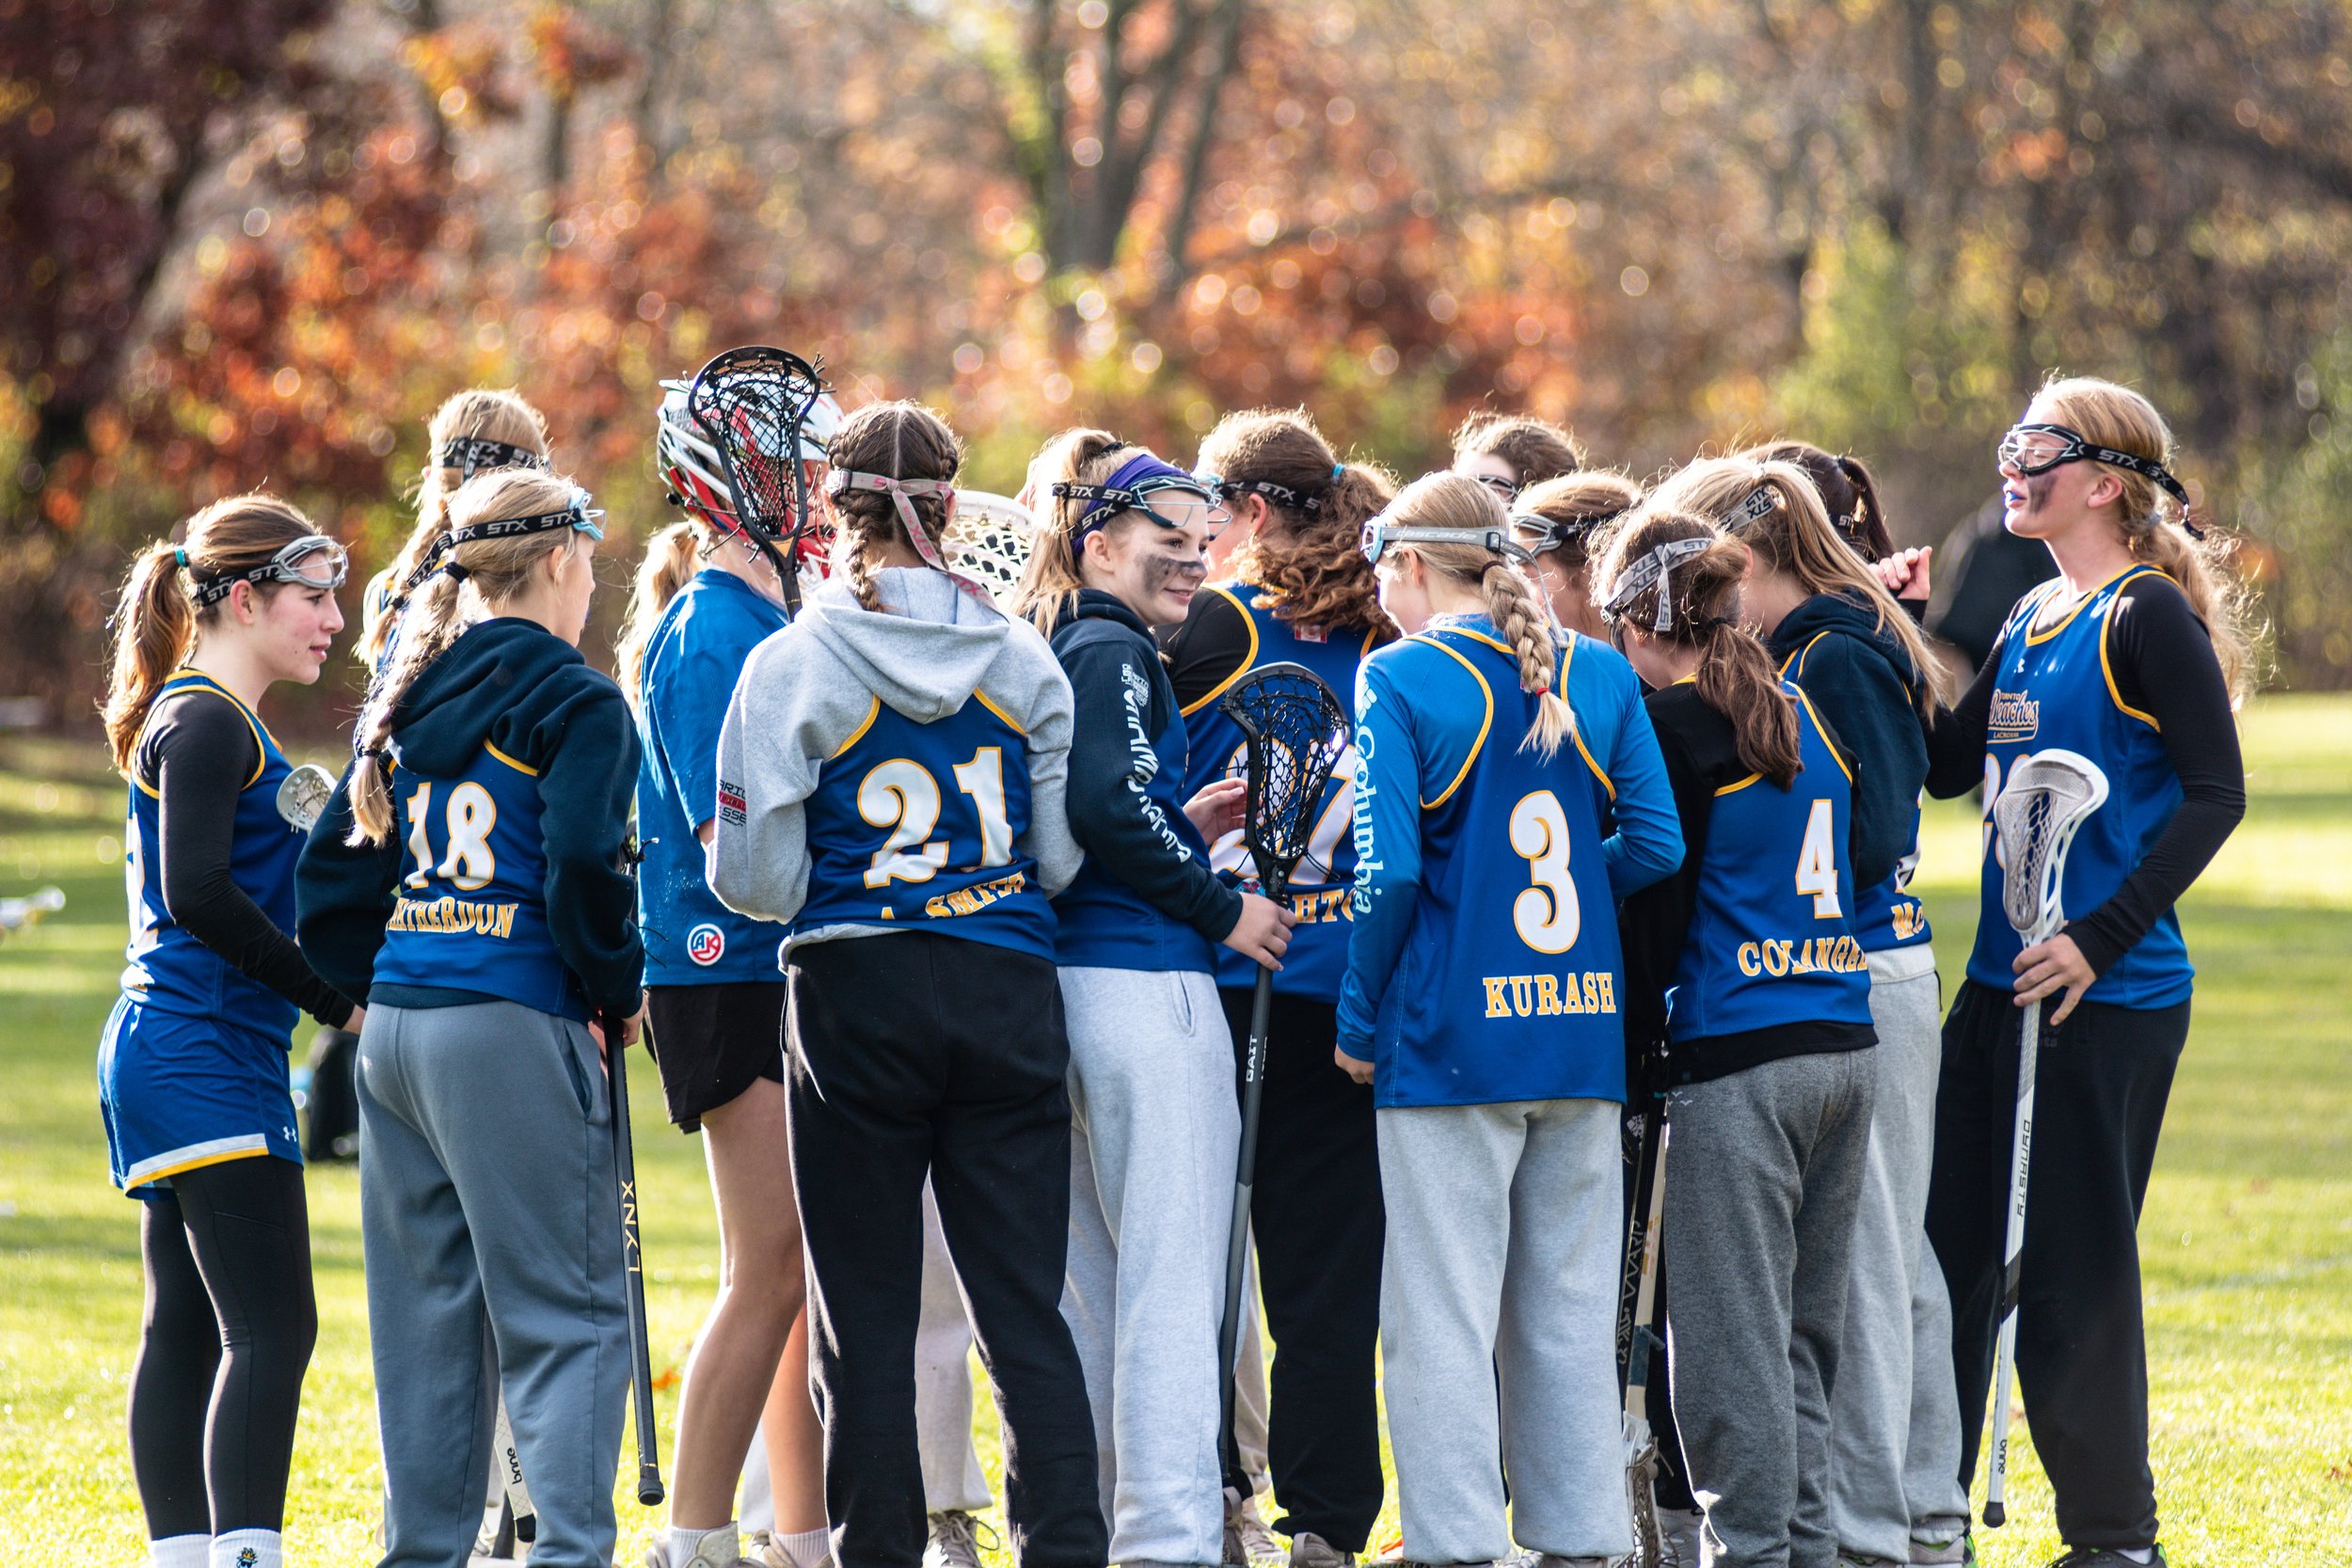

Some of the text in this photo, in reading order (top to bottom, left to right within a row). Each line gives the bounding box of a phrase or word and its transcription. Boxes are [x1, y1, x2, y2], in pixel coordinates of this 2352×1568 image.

[2098, 449, 2139, 469] STX
[1257, 482, 1296, 501] STX
[486, 519, 529, 535] STX
[540, 511, 577, 529] STX
[1082, 503, 1116, 530] STX
[405, 782, 497, 891] 18
[857, 746, 1018, 889] 21
[1509, 789, 1581, 955] 3
[1795, 799, 1844, 919] 4
[1483, 972, 1617, 1019] KURASH
[1246, 1034, 1258, 1083] GAIT
[621, 1180, 641, 1273] LYNX
